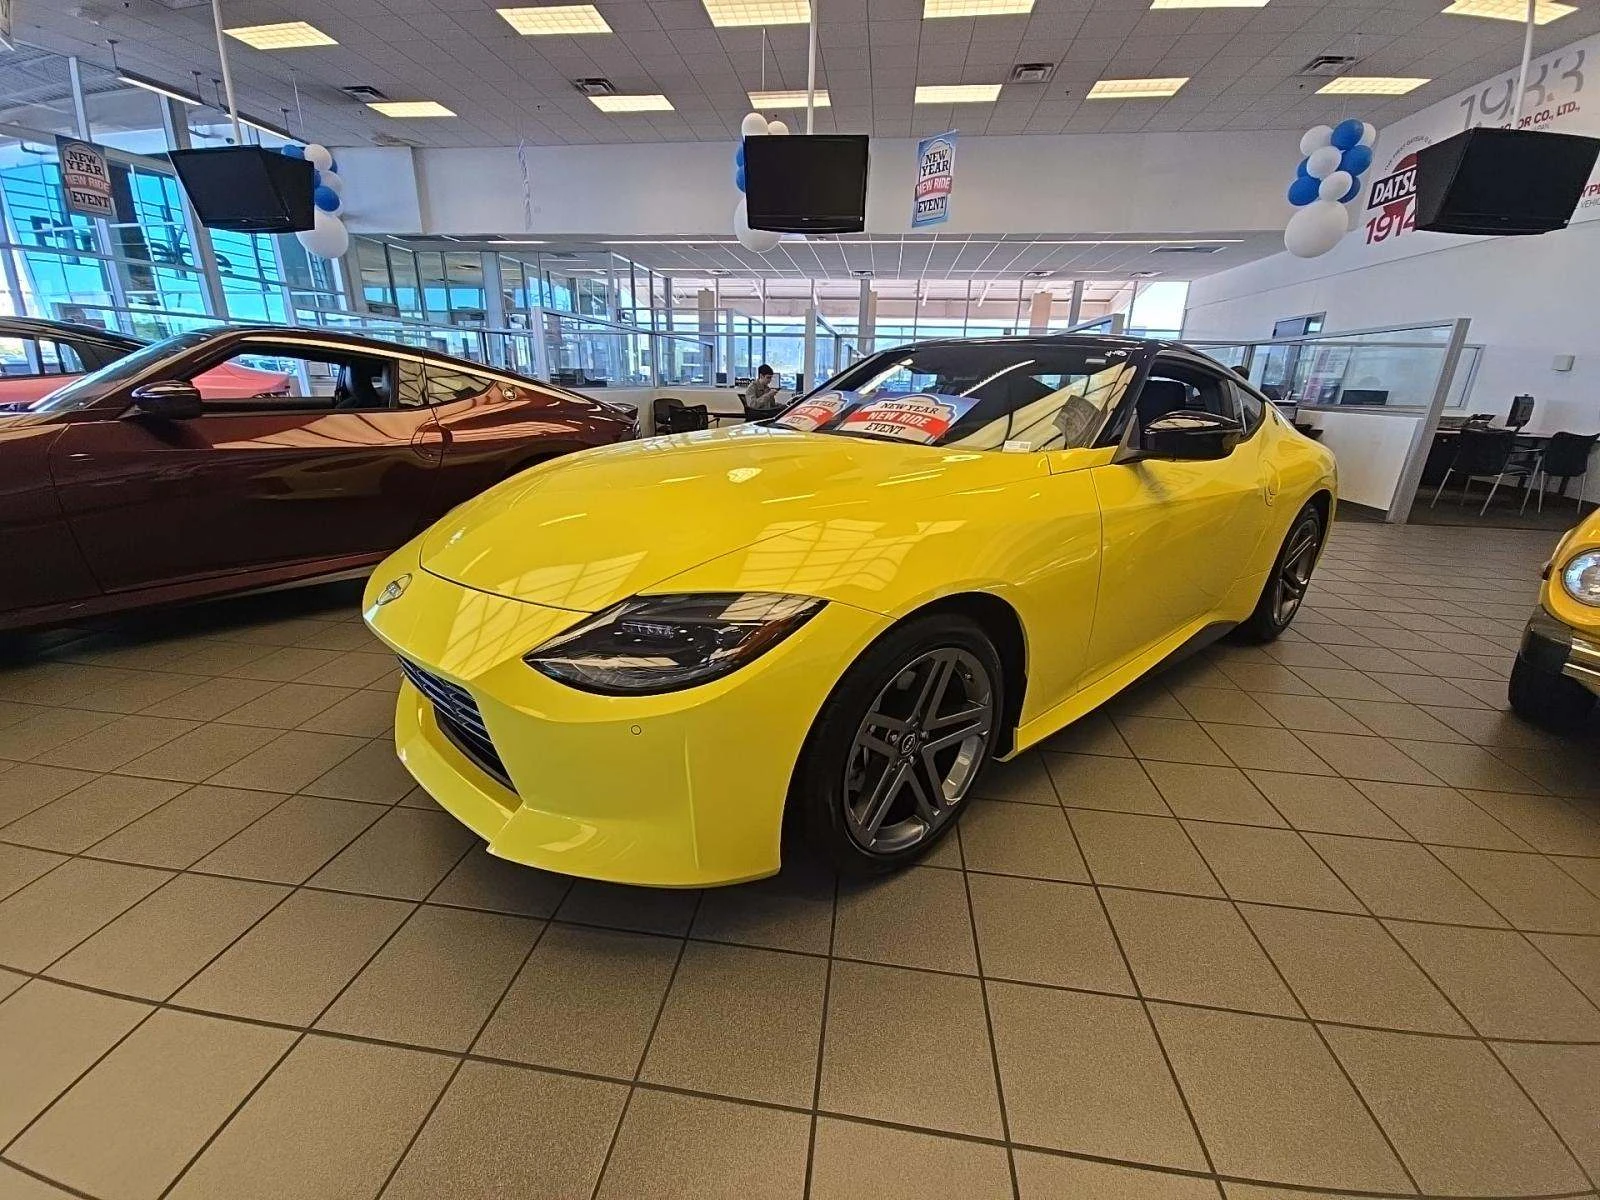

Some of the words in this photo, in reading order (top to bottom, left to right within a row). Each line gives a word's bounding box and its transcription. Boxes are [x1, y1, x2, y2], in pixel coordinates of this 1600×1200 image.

[68, 150, 96, 164] NEW
[925, 149, 948, 165] NEW
[66, 158, 103, 176] YEAR
[922, 159, 949, 176] YEAR
[916, 180, 934, 196] NEW
[933, 176, 951, 191] RIDE
[72, 190, 109, 207] EVENT
[917, 196, 946, 214] EVENT
[1366, 211, 1417, 245] 1914
[880, 402, 908, 410] NEW
[906, 403, 940, 415] YEAR
[867, 411, 898, 421] NEW
[897, 412, 932, 427] RIDE
[864, 422, 906, 434] EVENT
